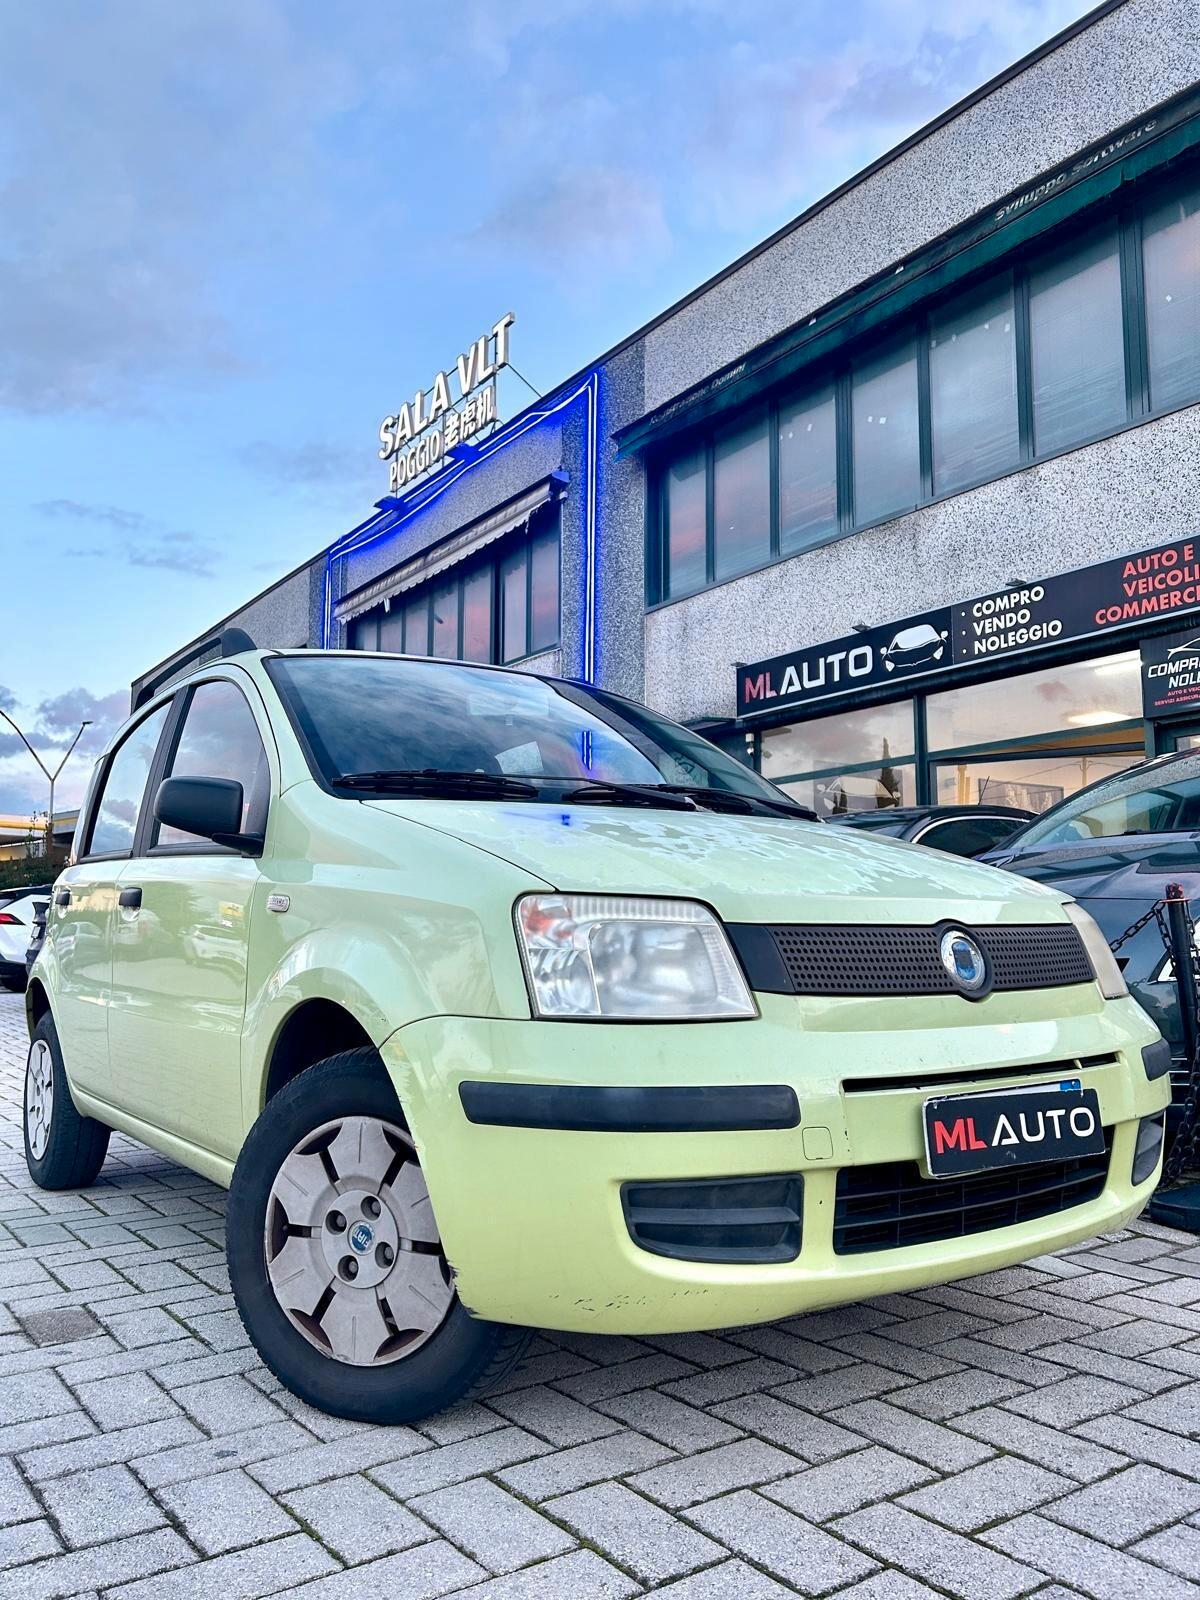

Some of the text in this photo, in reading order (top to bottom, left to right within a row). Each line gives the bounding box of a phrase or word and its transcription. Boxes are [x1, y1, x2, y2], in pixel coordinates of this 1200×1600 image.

[378, 311, 515, 460] SALA VLT
[443, 385, 496, 449] 老虎机
[389, 429, 443, 492] POGGIO
[1122, 543, 1194, 578] AUTO E
[1122, 563, 1200, 598] VEICOLI
[972, 586, 1045, 618] COMPRO
[973, 609, 1031, 636] VENDO
[974, 620, 1063, 655] NOLEGGIO
[745, 645, 873, 703] ML AUTO
[1147, 657, 1200, 679] COMPR
[1167, 689, 1182, 697] AUTO
[934, 1106, 1095, 1154] ML AUTO
